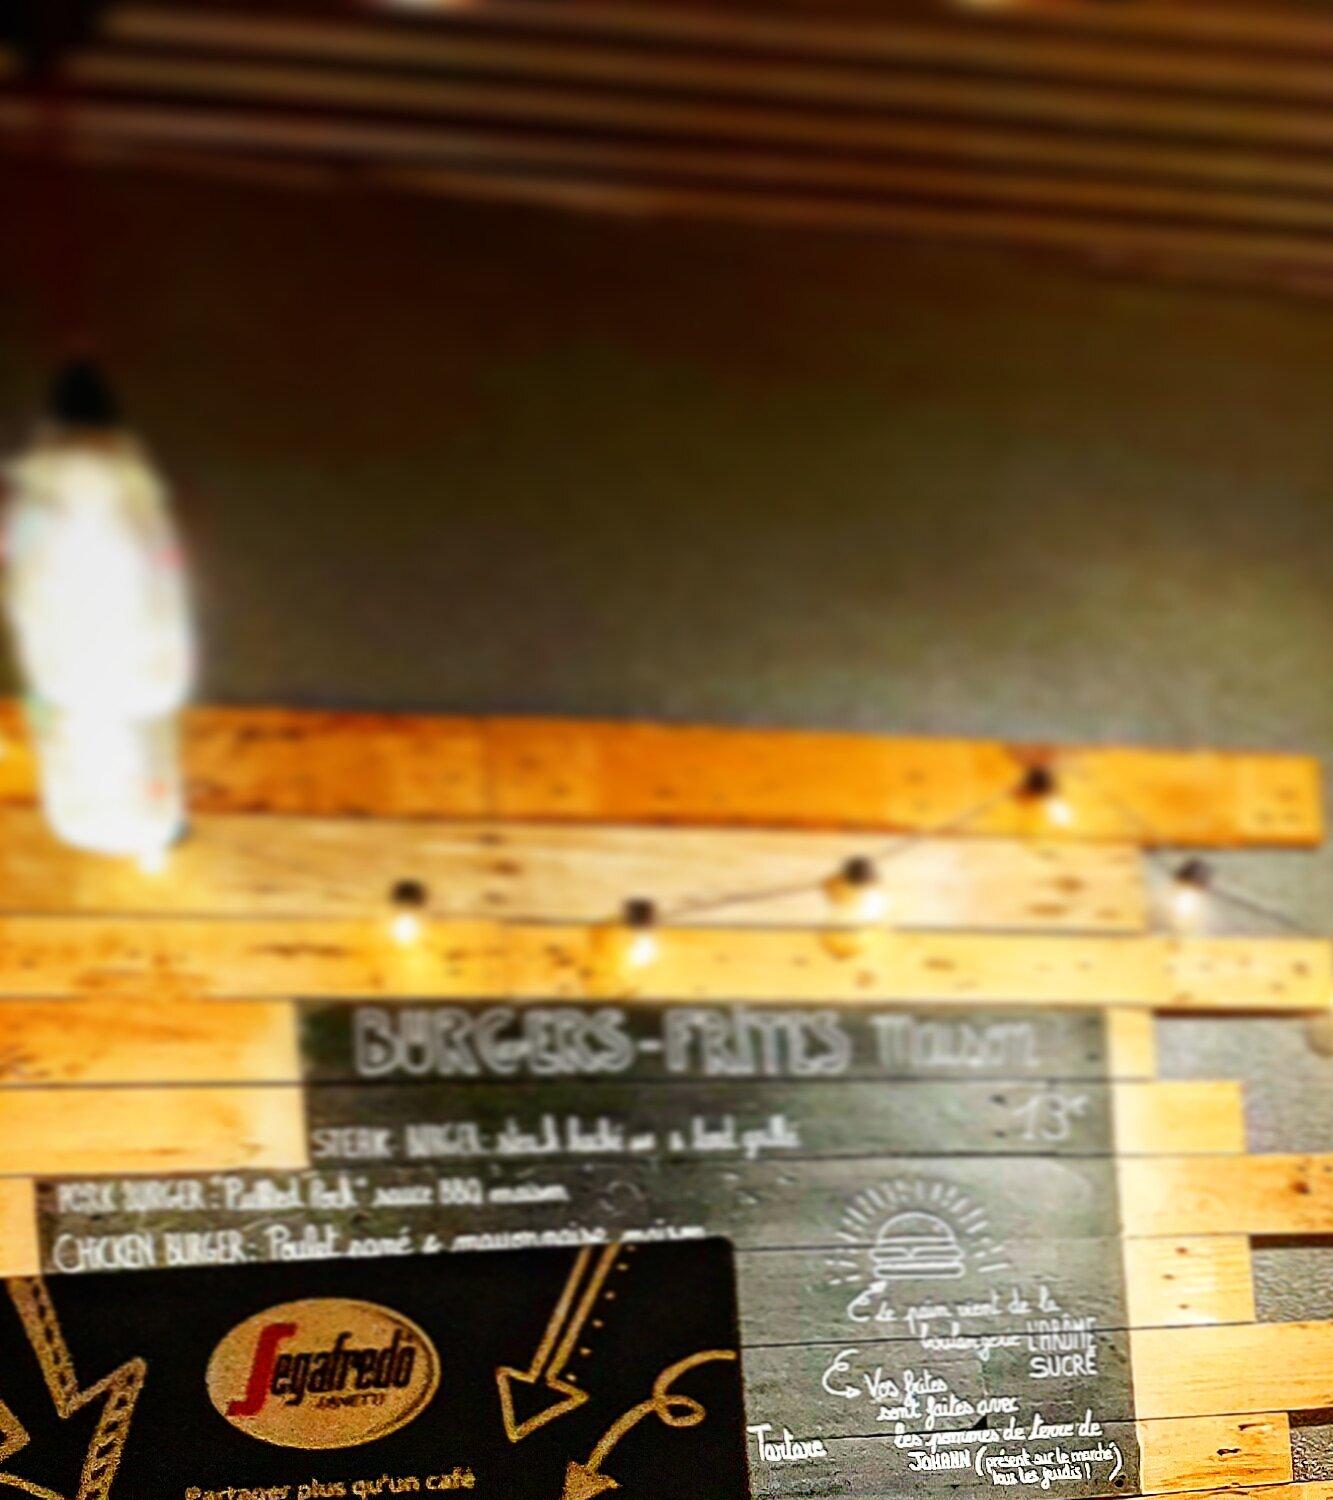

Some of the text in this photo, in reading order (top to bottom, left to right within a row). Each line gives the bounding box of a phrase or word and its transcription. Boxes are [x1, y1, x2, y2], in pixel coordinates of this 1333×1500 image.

[53, 1234, 156, 1273] CHICKEN
[224, 1321, 417, 1418] Segafredo
[907, 1449, 972, 1472] JOHANN
[424, 1465, 477, 1491] café
